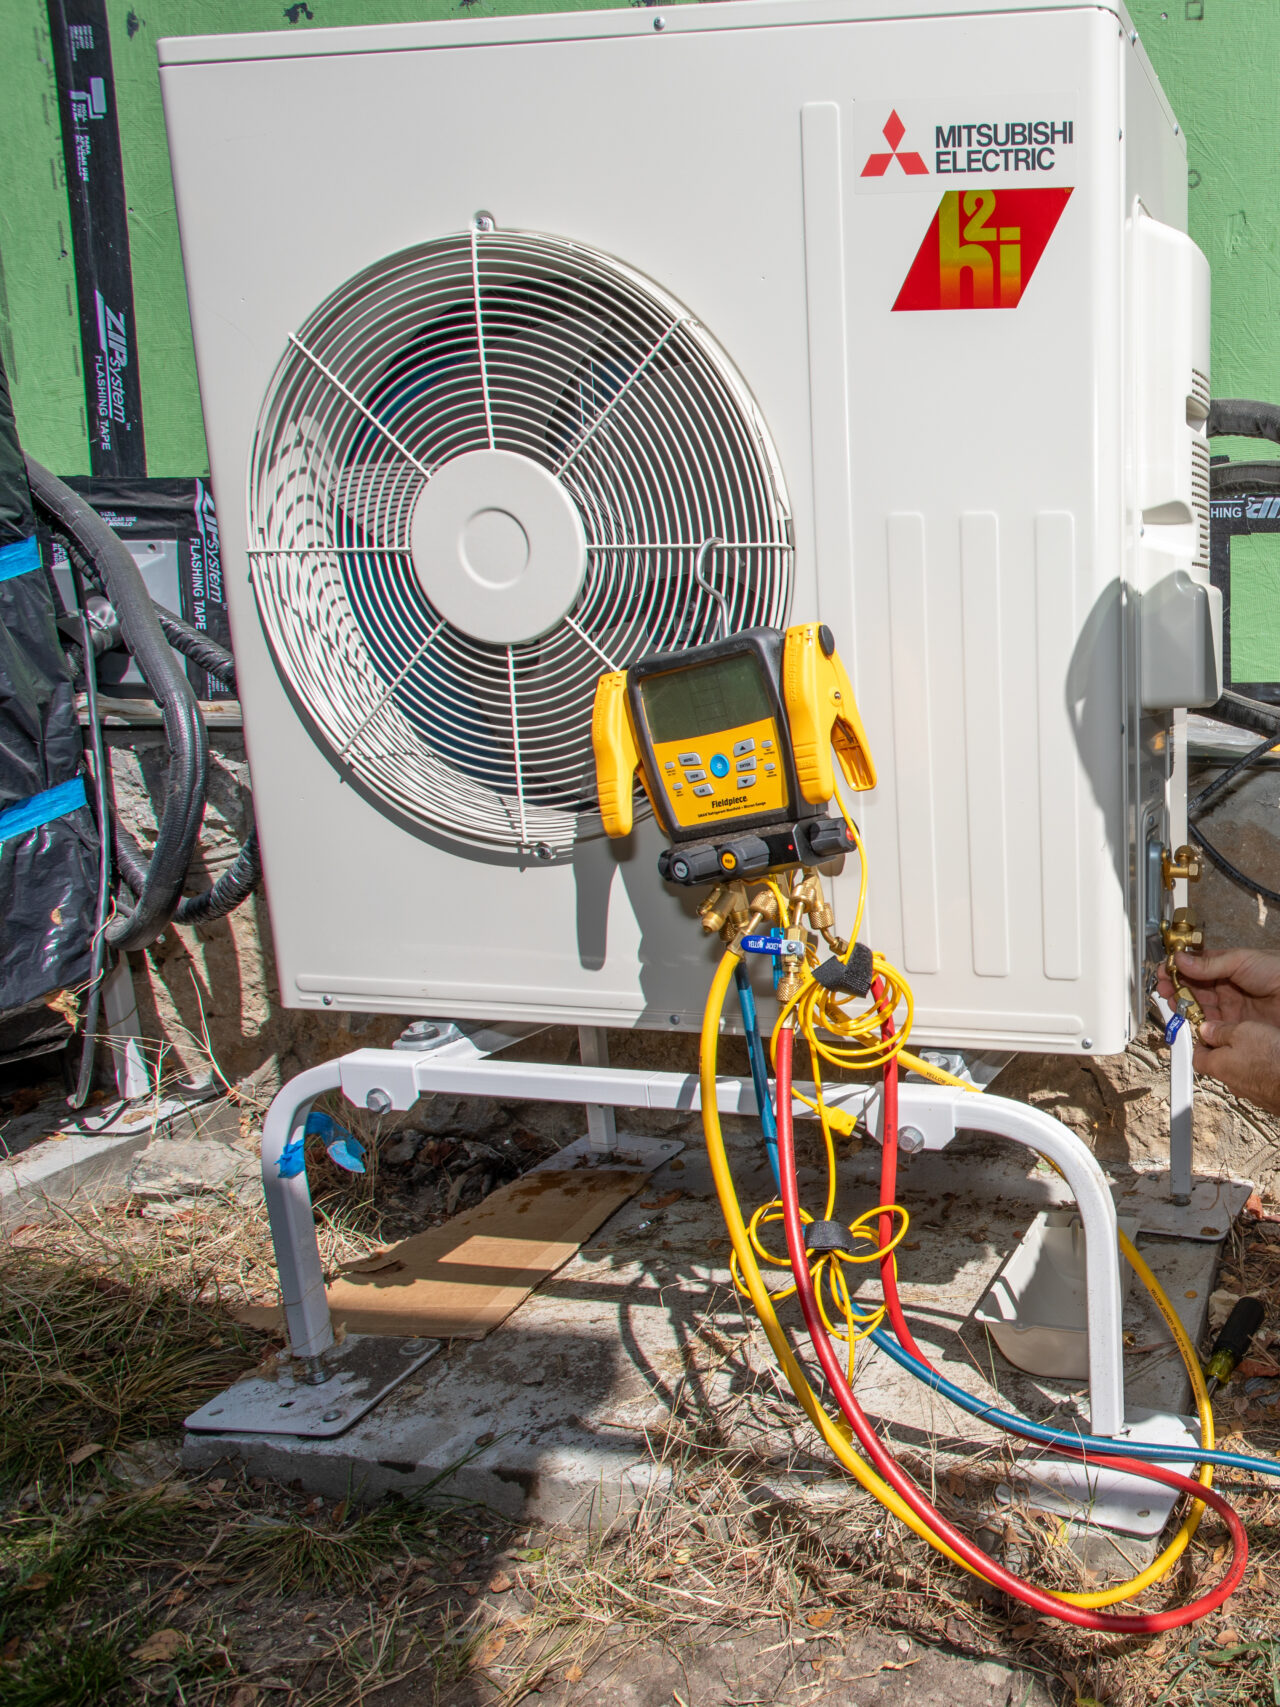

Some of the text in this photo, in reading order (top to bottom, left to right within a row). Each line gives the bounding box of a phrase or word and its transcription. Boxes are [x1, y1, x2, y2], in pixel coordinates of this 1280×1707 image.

[935, 121, 1074, 149] MITSUBISHI
[936, 147, 1055, 174] ELECTRIC
[95, 355, 112, 451] FLASHING TAPE
[190, 538, 207, 630] FLASHING TAPE
[711, 795, 748, 809] Fieldpiece
